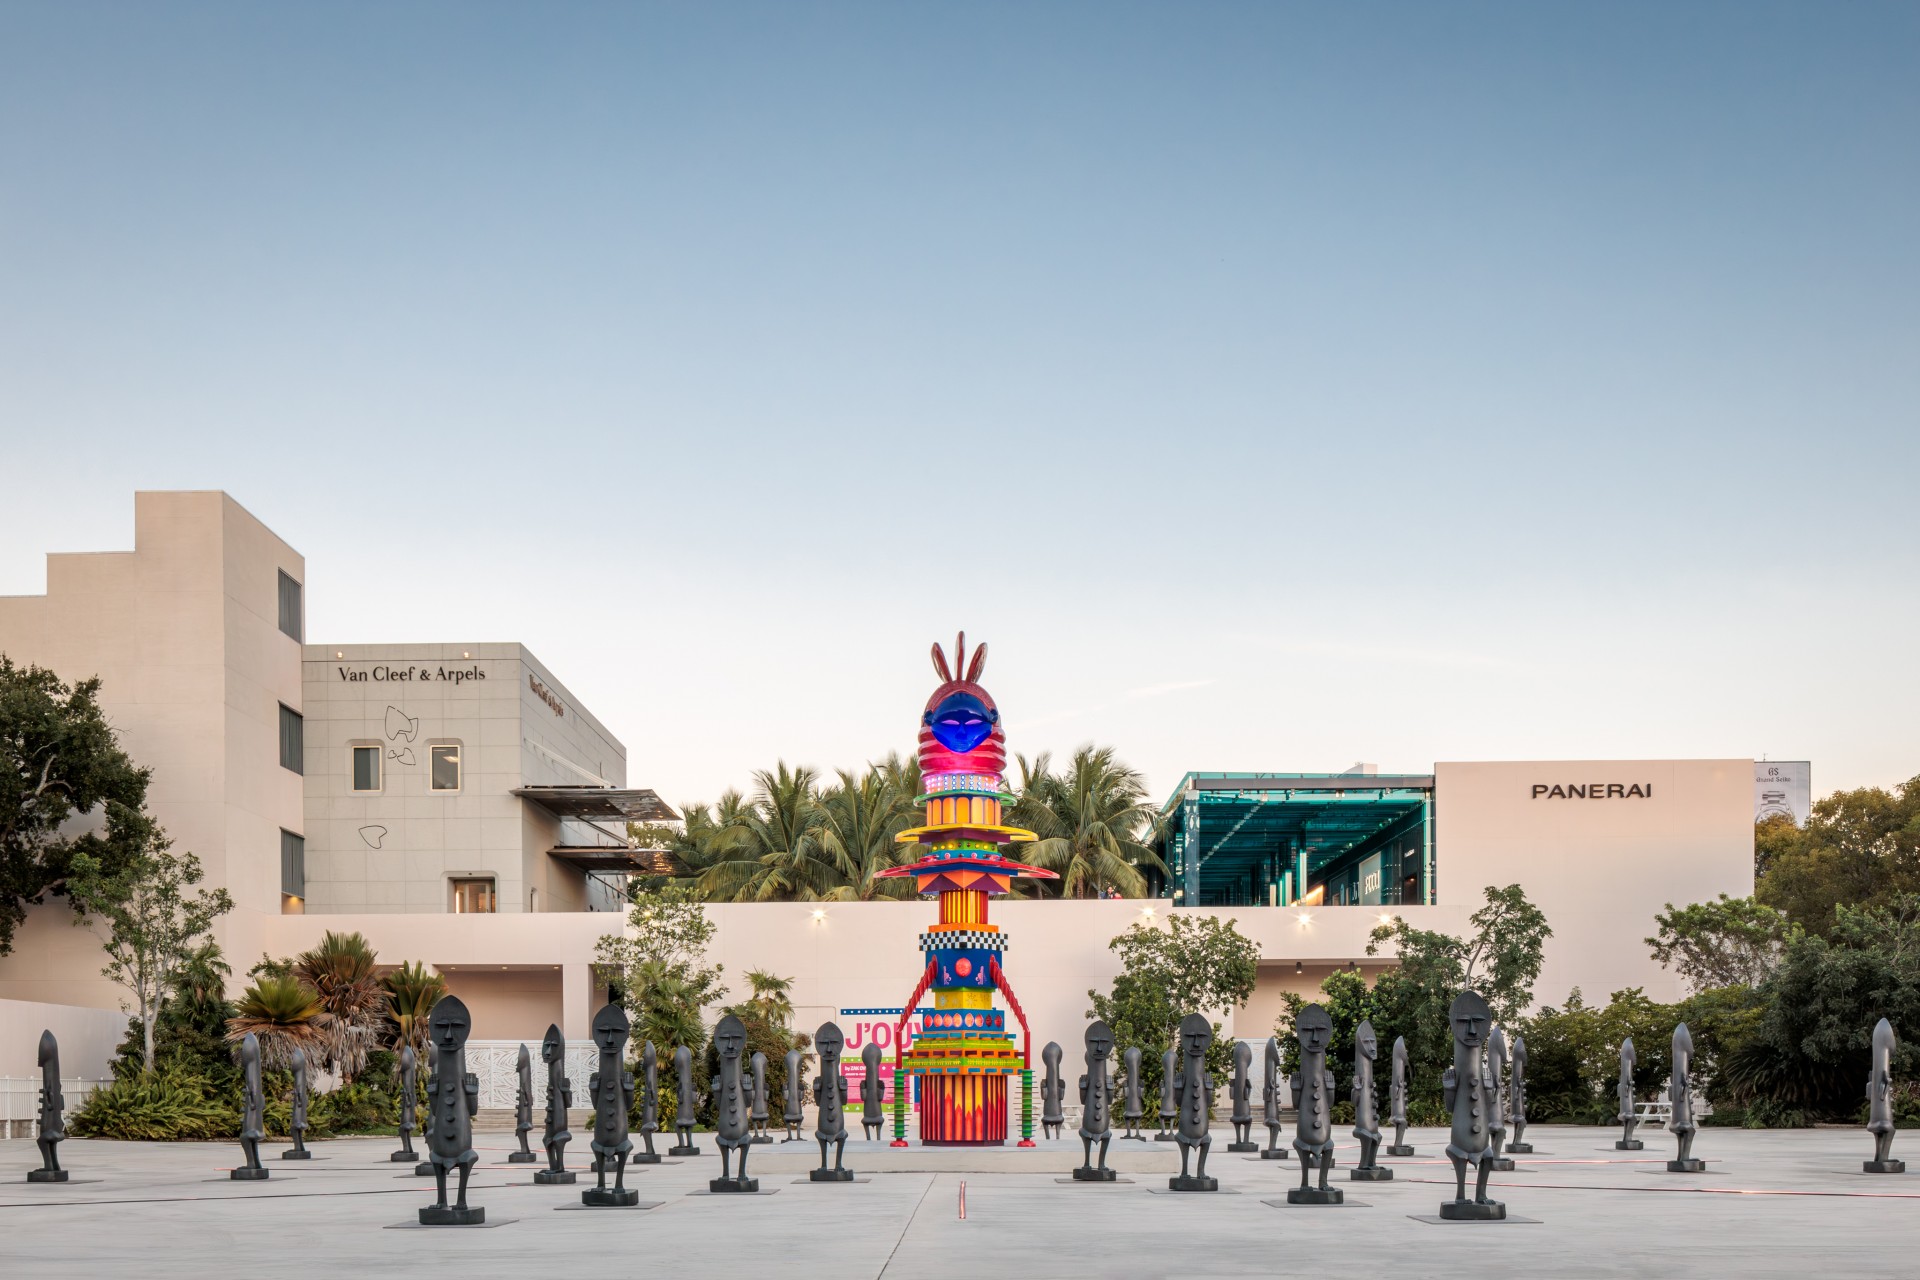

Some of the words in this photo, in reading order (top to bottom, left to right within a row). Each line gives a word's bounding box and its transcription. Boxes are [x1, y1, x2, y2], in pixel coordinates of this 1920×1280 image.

[338, 667, 368, 681] Van
[372, 666, 416, 681] Cleef
[419, 669, 431, 681] &
[435, 665, 486, 685] Arpels
[1532, 783, 1652, 799] PANERAI
